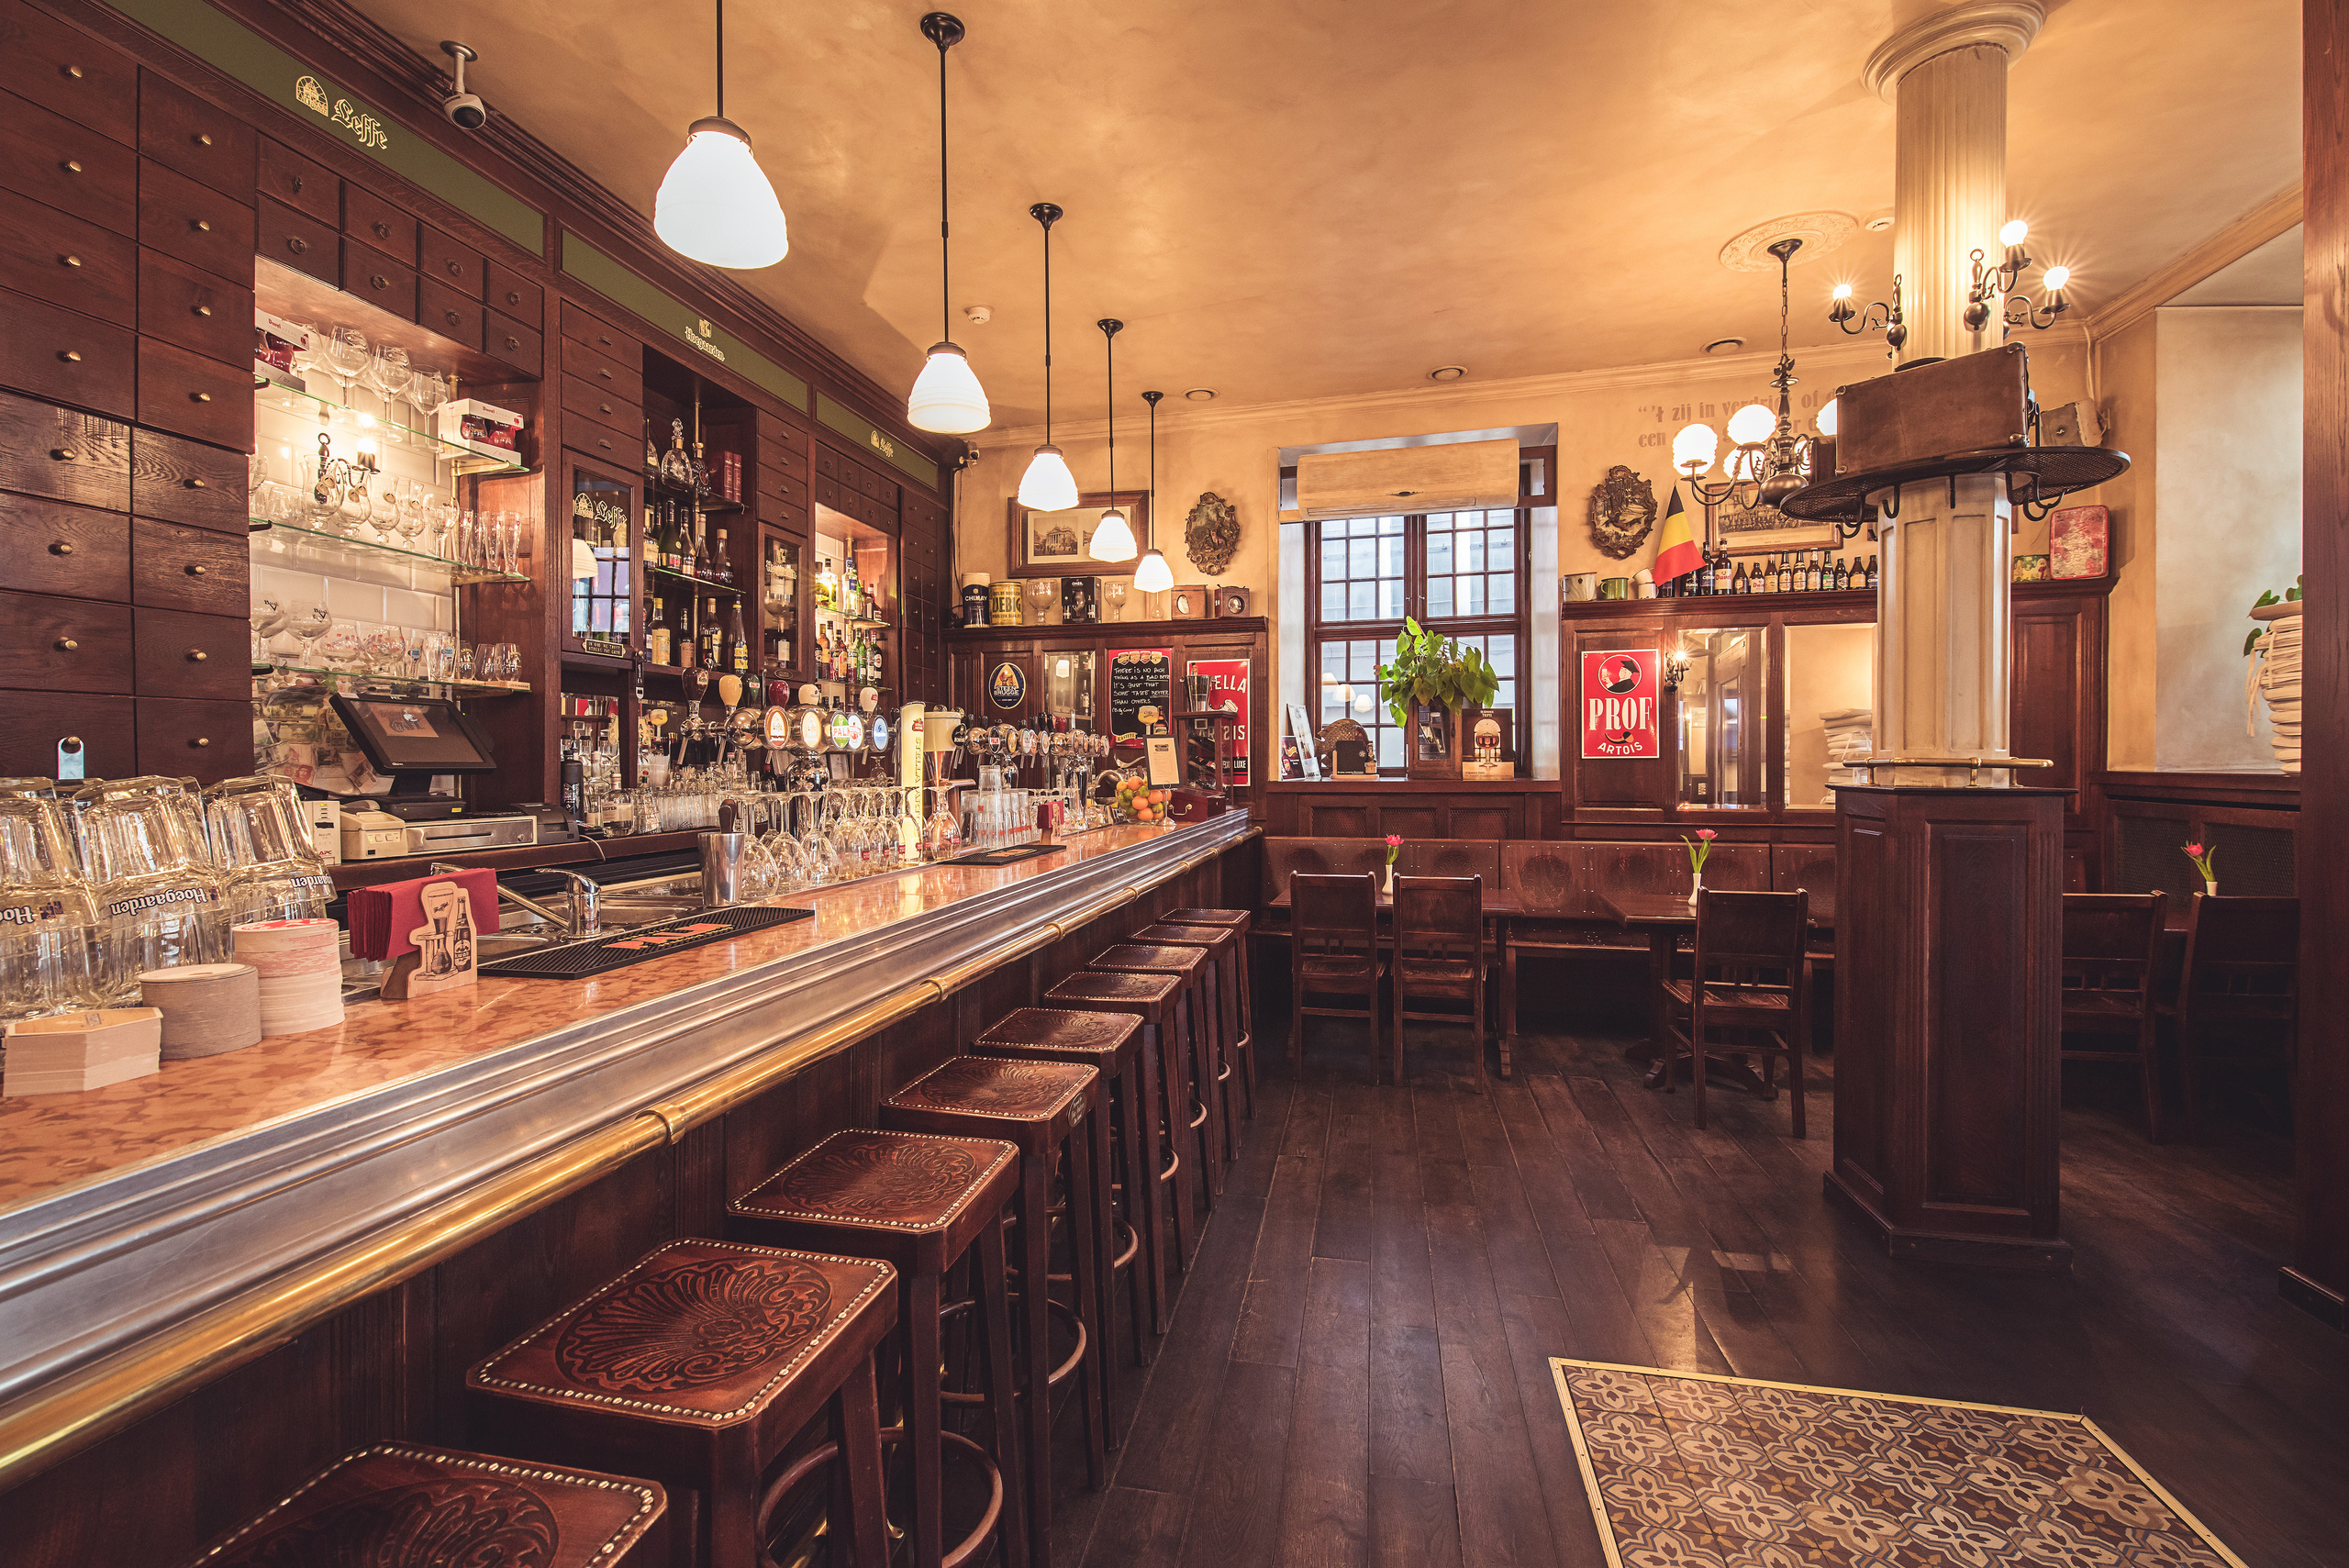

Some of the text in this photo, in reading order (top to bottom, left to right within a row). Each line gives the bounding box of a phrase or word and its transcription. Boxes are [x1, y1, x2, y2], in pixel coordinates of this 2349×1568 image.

[331, 98, 388, 150] Leffe
[685, 326, 726, 362] Hoegaarden
[1672, 403, 1692, 422] zij
[1698, 401, 1716, 419] in
[1800, 390, 1819, 409] of
[880, 437, 894, 458] Leffe
[1638, 432, 1666, 448] een
[595, 500, 628, 529] Leffe
[1210, 674, 1247, 694] ELLA
[1588, 696, 1653, 731] PROF
[1597, 741, 1643, 755] ARTOIS
[1233, 760, 1246, 769] LUXE
[108, 886, 209, 917] Hoegaarden
